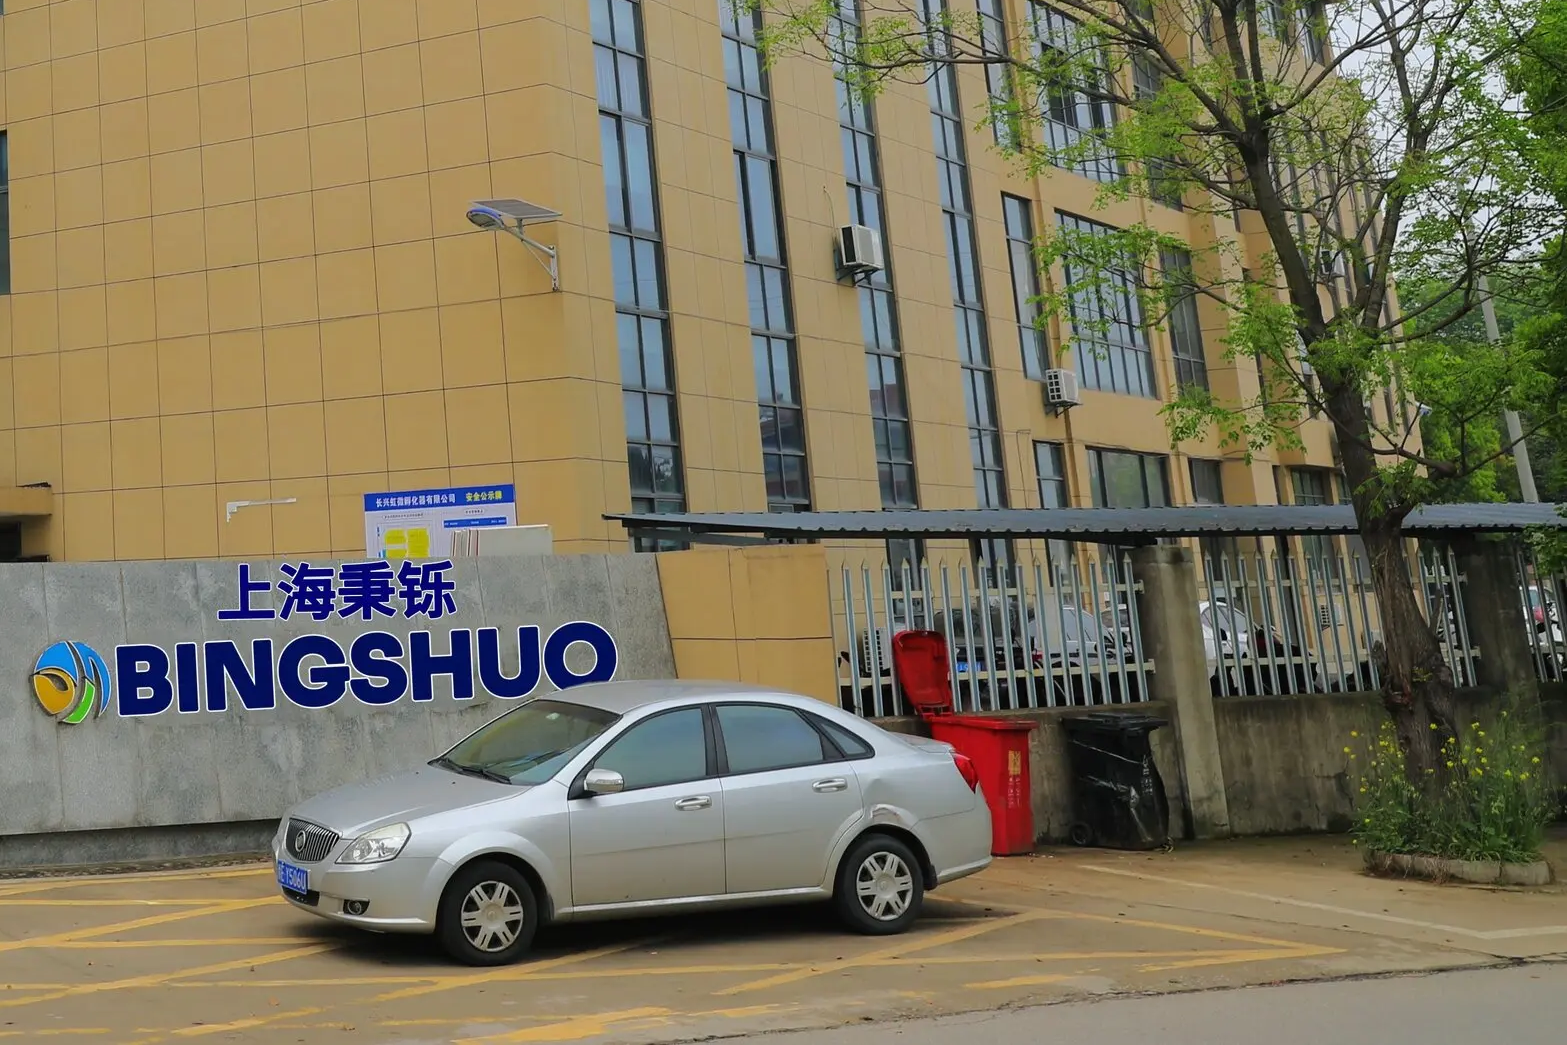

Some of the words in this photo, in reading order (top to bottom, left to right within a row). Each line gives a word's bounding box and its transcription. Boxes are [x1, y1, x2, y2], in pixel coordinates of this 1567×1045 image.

[218, 560, 457, 621] 上海秉铄
[116, 621, 619, 717] BINGSHUO
